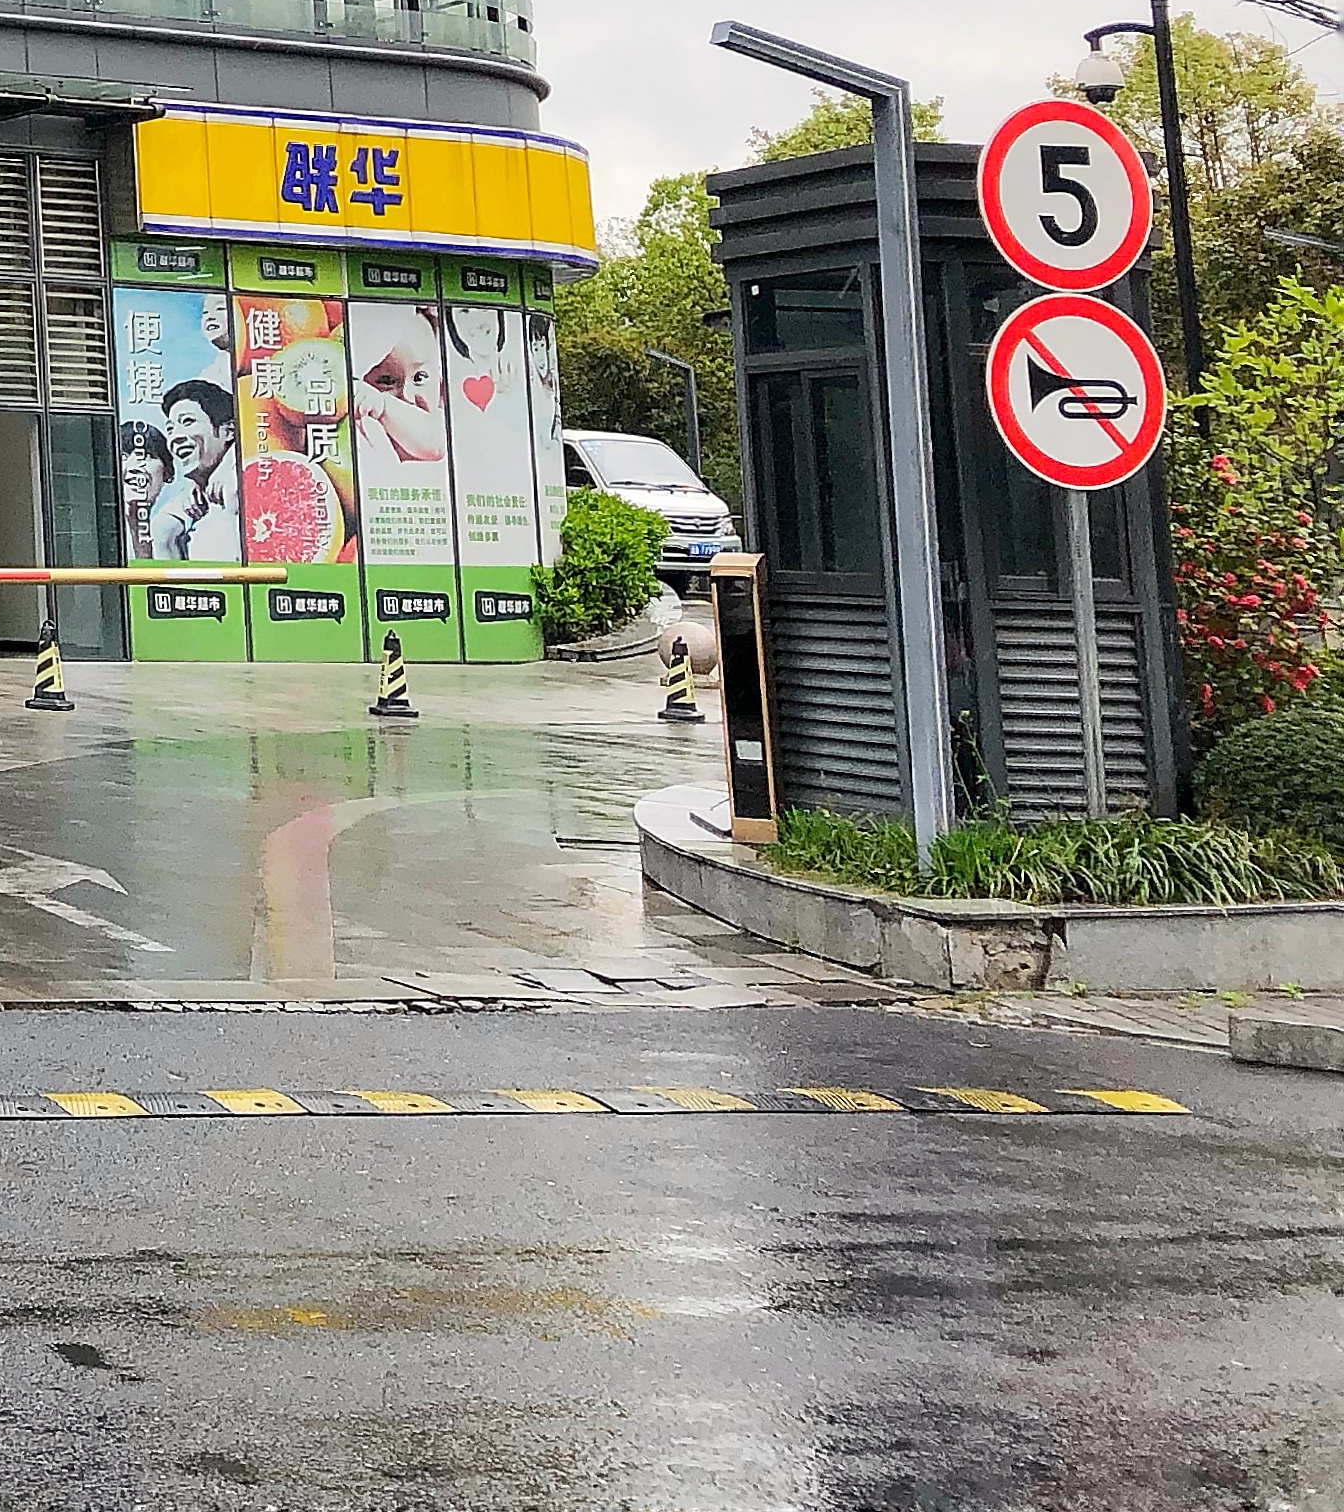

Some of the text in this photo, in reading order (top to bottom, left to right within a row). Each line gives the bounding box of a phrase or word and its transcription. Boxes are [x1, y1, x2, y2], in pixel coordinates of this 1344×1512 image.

[280, 141, 405, 217] 联华
[1039, 145, 1099, 247] 5
[125, 310, 164, 404] 便捷
[246, 308, 285, 399] 健康
[256, 412, 274, 481] Health
[305, 378, 341, 464] 品质
[132, 421, 154, 543] Convenient
[312, 481, 332, 552] Quality
